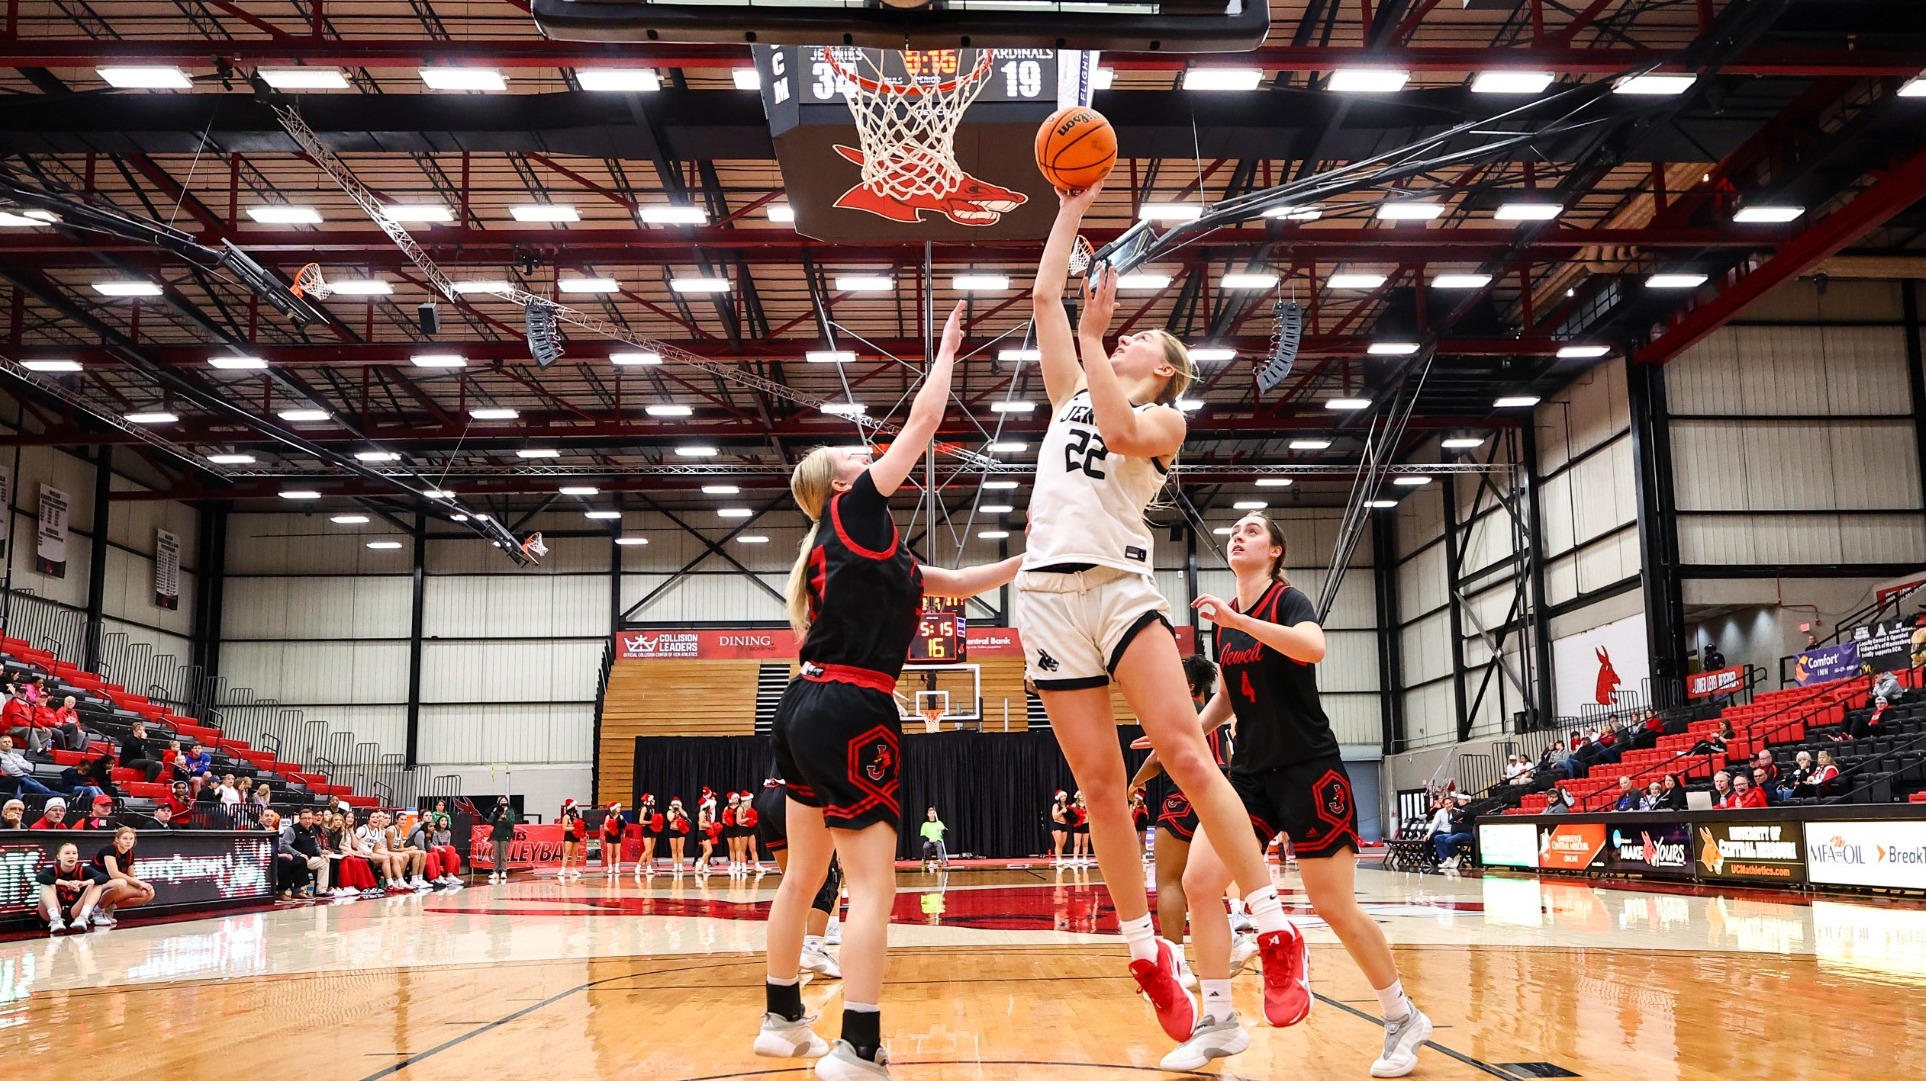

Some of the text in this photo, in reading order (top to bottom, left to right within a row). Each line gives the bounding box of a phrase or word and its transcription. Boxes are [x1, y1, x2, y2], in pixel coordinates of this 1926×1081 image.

[770, 44, 790, 105] CM
[1001, 61, 1042, 97] 19
[1080, 54, 1090, 101] FLIGHT
[1065, 428, 1109, 480] 22
[920, 621, 953, 637] 5:15
[659, 633, 698, 643] COLLISION
[719, 635, 771, 646] DINING
[990, 636, 1011, 645] Bank
[659, 643, 698, 652] LEADERS
[928, 637, 945, 657] 16
[1808, 653, 1839, 669] Comfort
[1817, 667, 1829, 677] INN
[1241, 671, 1256, 703] 4
[1620, 845, 1644, 860] MAKE
[1810, 844, 1866, 864] MFA OIL
[1730, 864, 1791, 877] UCMathletics.com
